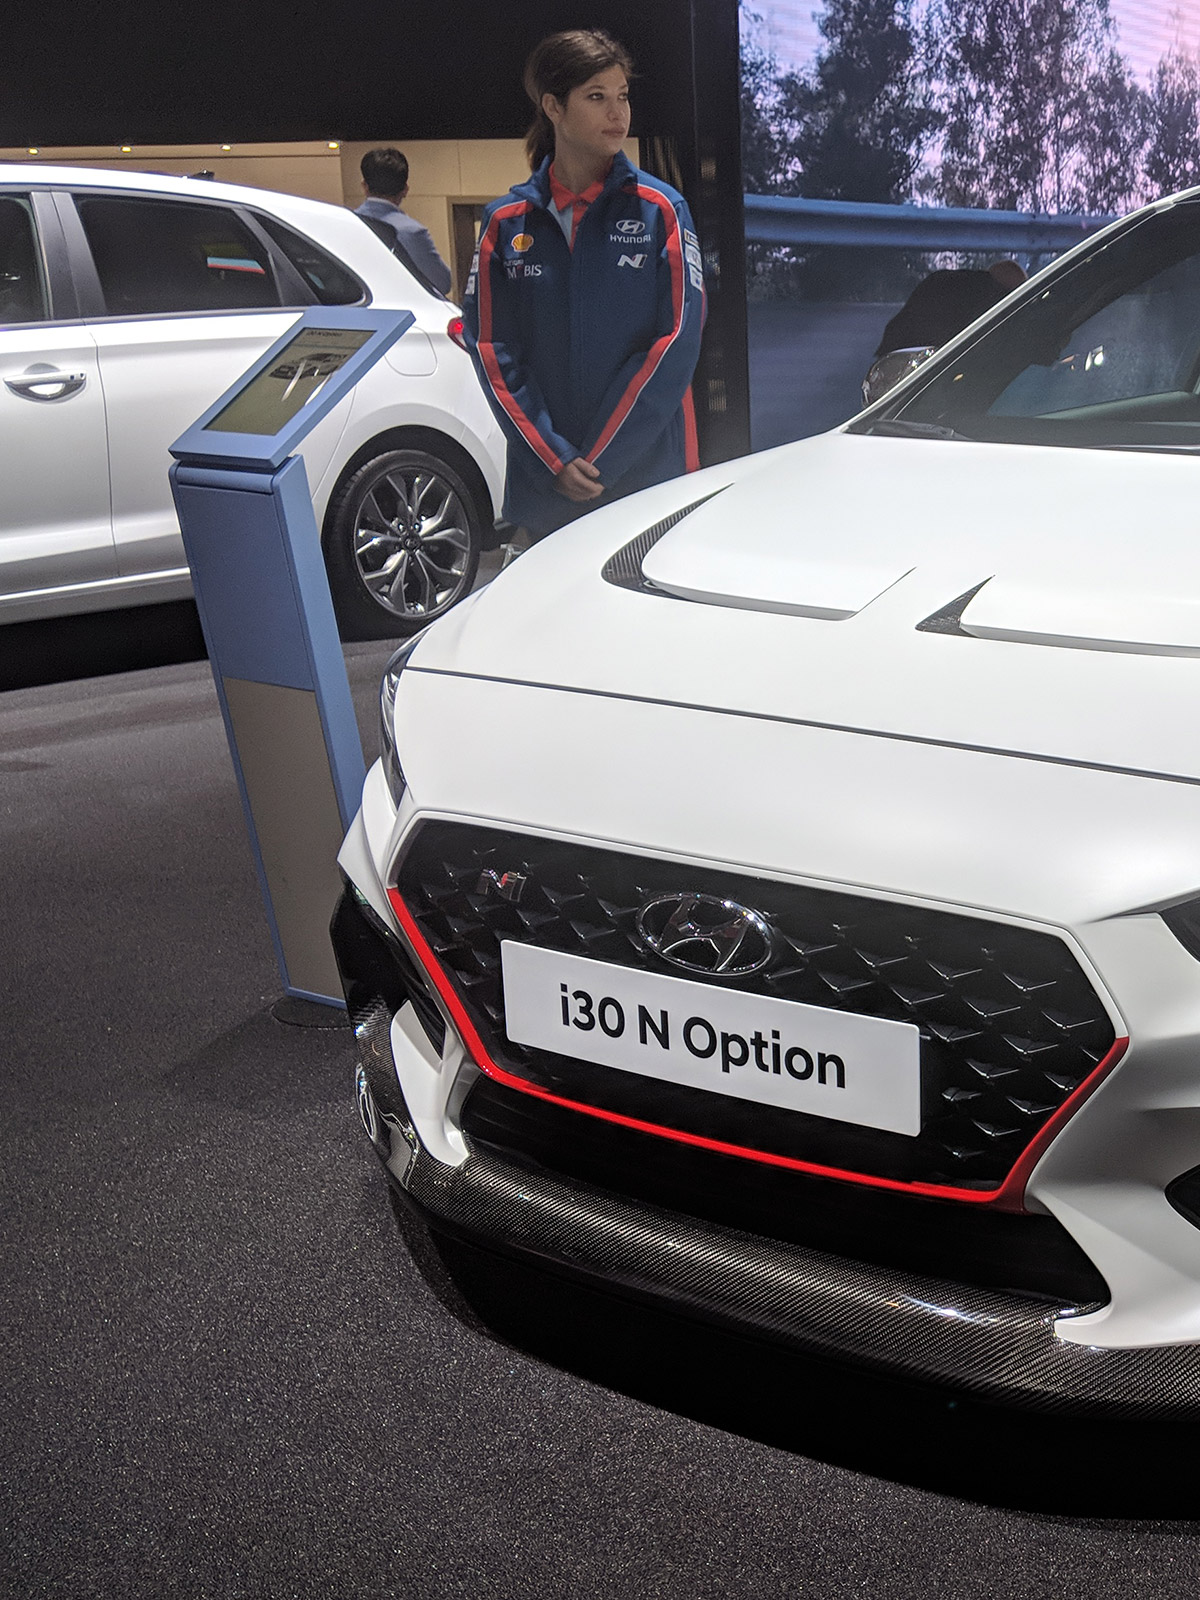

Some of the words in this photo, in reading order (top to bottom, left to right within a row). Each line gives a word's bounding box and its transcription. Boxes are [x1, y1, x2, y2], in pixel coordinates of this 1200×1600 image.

[609, 233, 652, 244] HYUNDAI
[560, 982, 626, 1039] i30
[637, 1003, 671, 1051] N
[683, 1015, 846, 1090] Option
